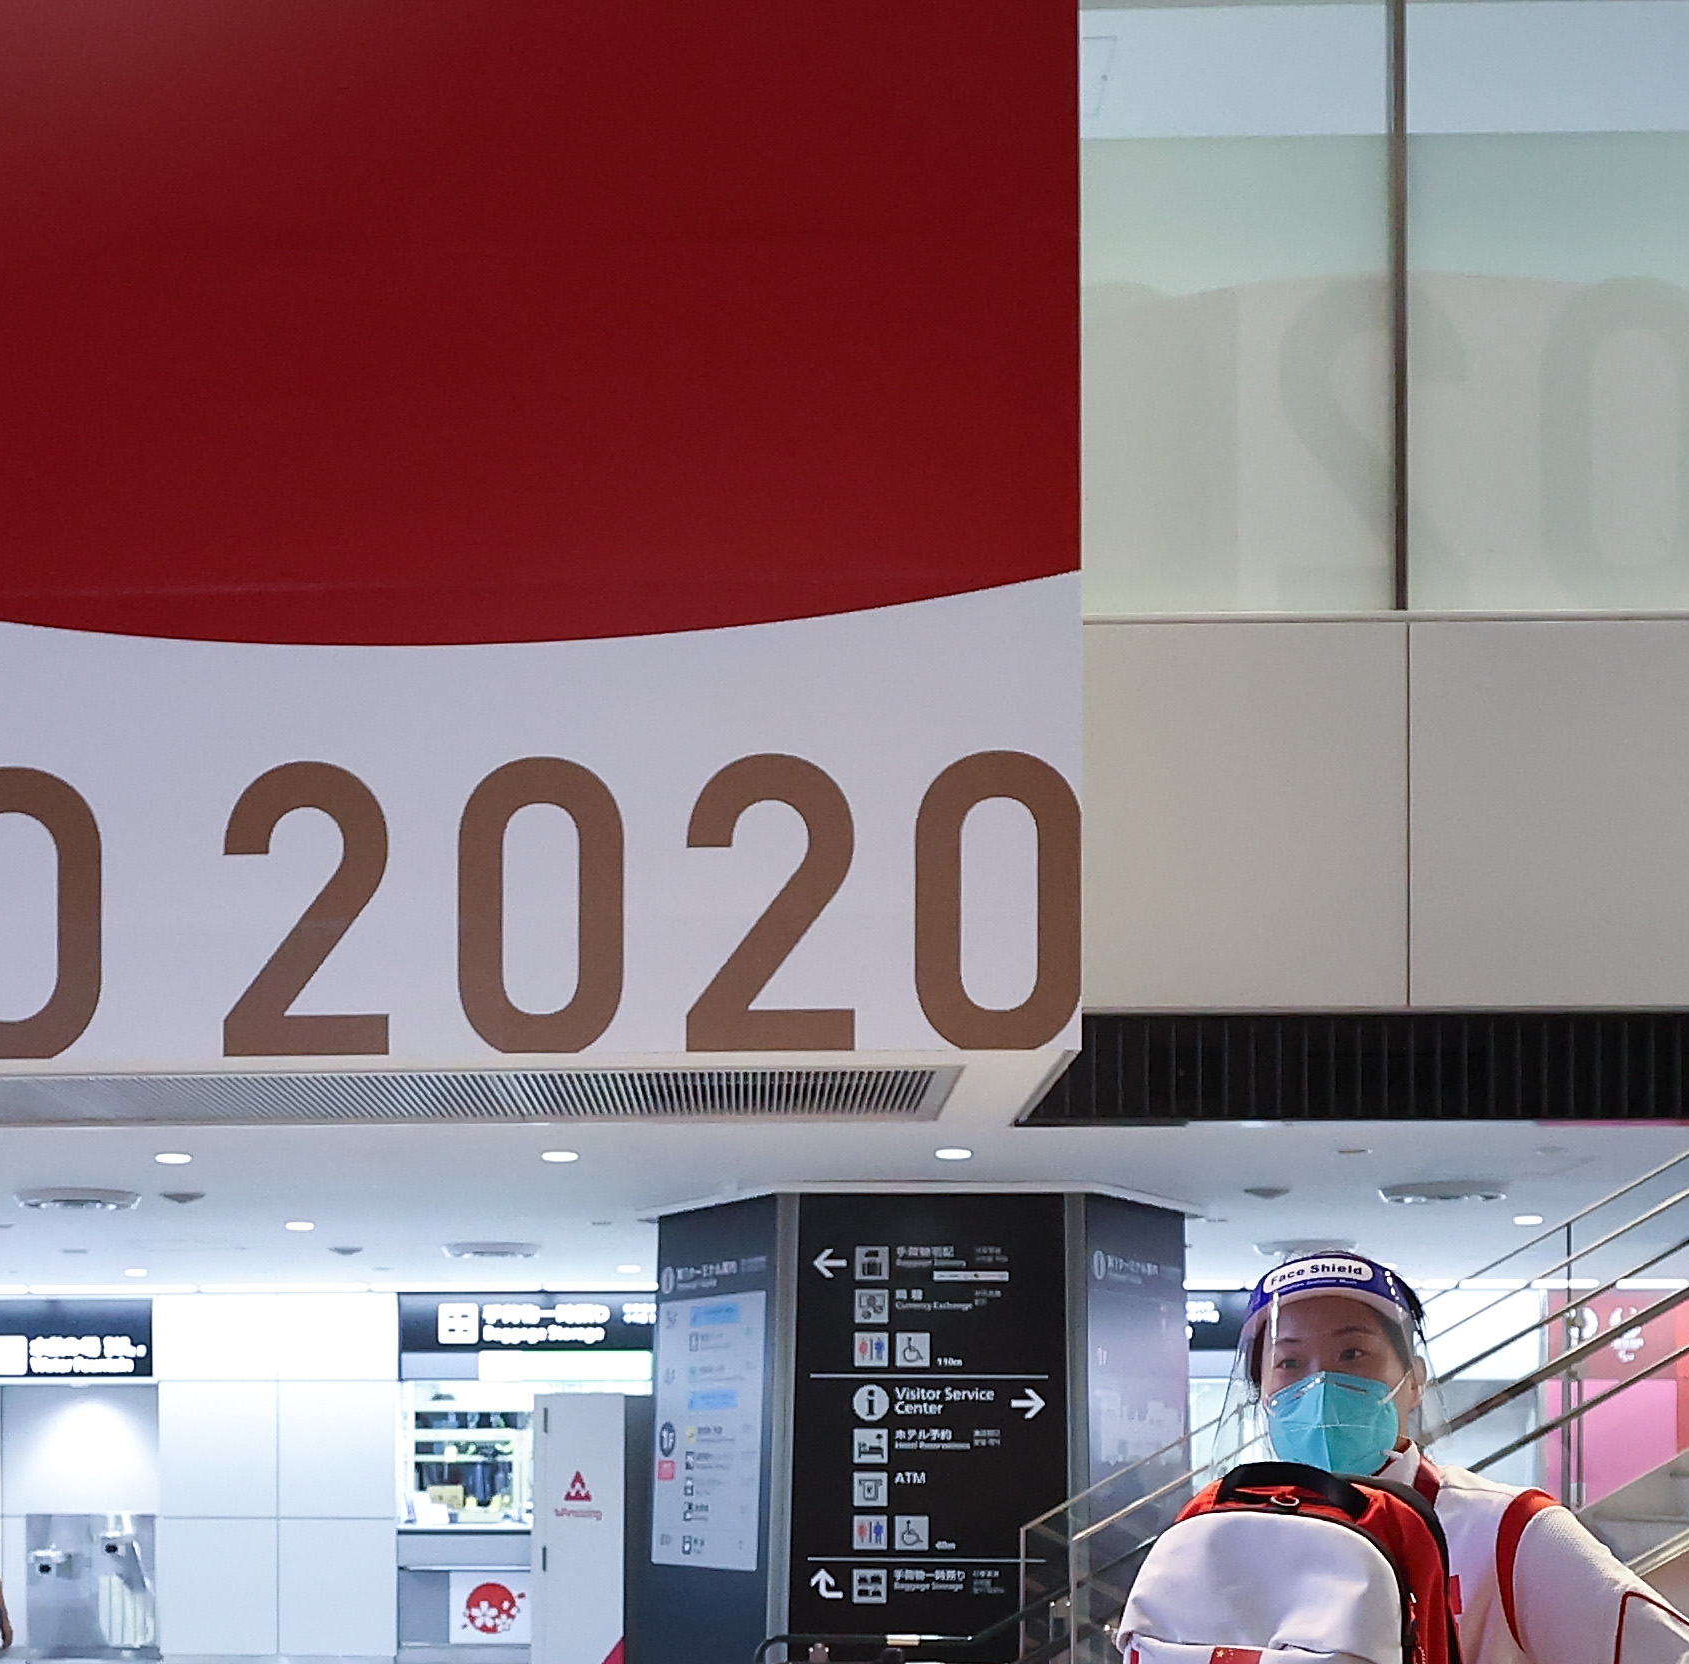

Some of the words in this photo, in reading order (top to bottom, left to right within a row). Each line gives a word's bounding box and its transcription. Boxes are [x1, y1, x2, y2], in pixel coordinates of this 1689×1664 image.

[222, 750, 1081, 1056] 2020
[1270, 1269, 1306, 1286] Face
[1309, 1263, 1363, 1276] Shield
[894, 1386, 942, 1401] Visitor
[944, 1386, 995, 1401] Service
[894, 1401, 944, 1415] Center
[893, 1471, 927, 1485] ATM
